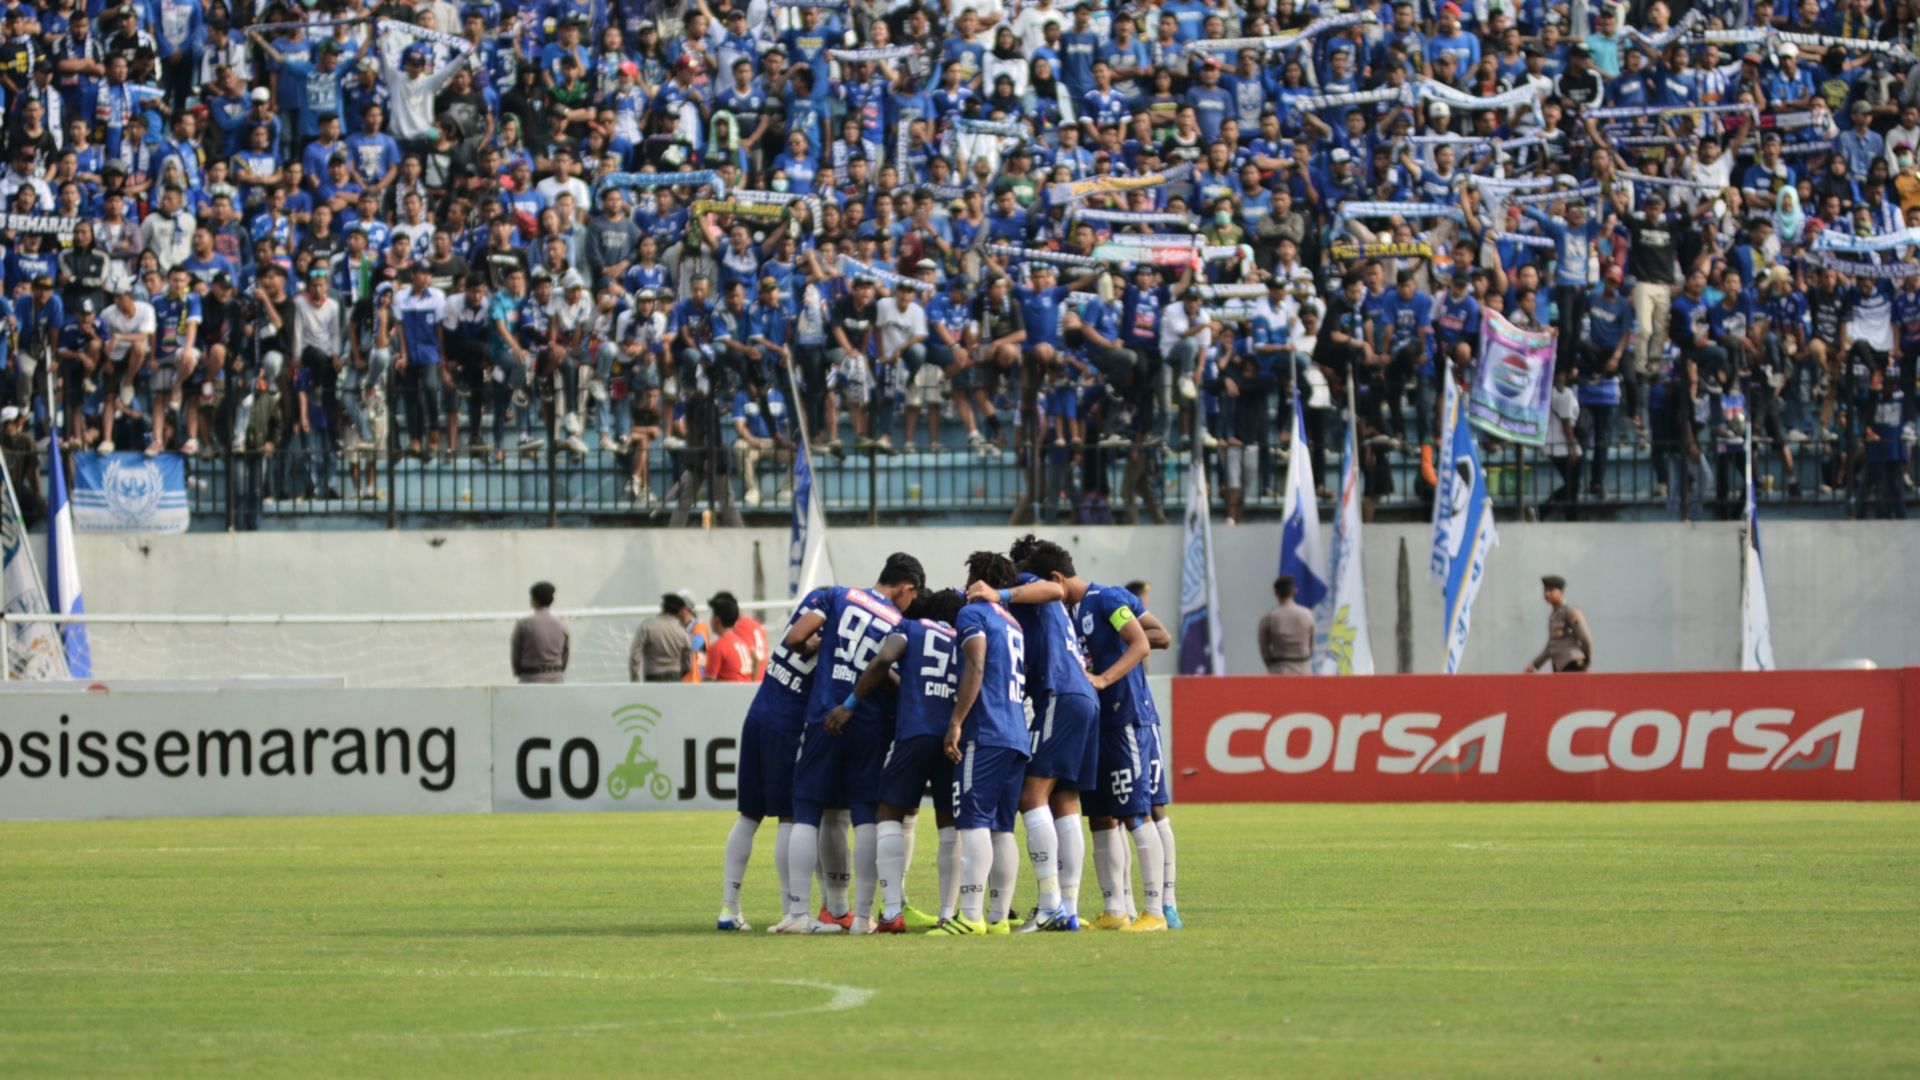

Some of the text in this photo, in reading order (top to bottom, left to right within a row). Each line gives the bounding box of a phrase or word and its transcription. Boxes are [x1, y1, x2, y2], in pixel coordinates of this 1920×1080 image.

[834, 605, 892, 671] 92
[516, 737, 738, 800] GO JE
[1110, 768, 1133, 796] 22
